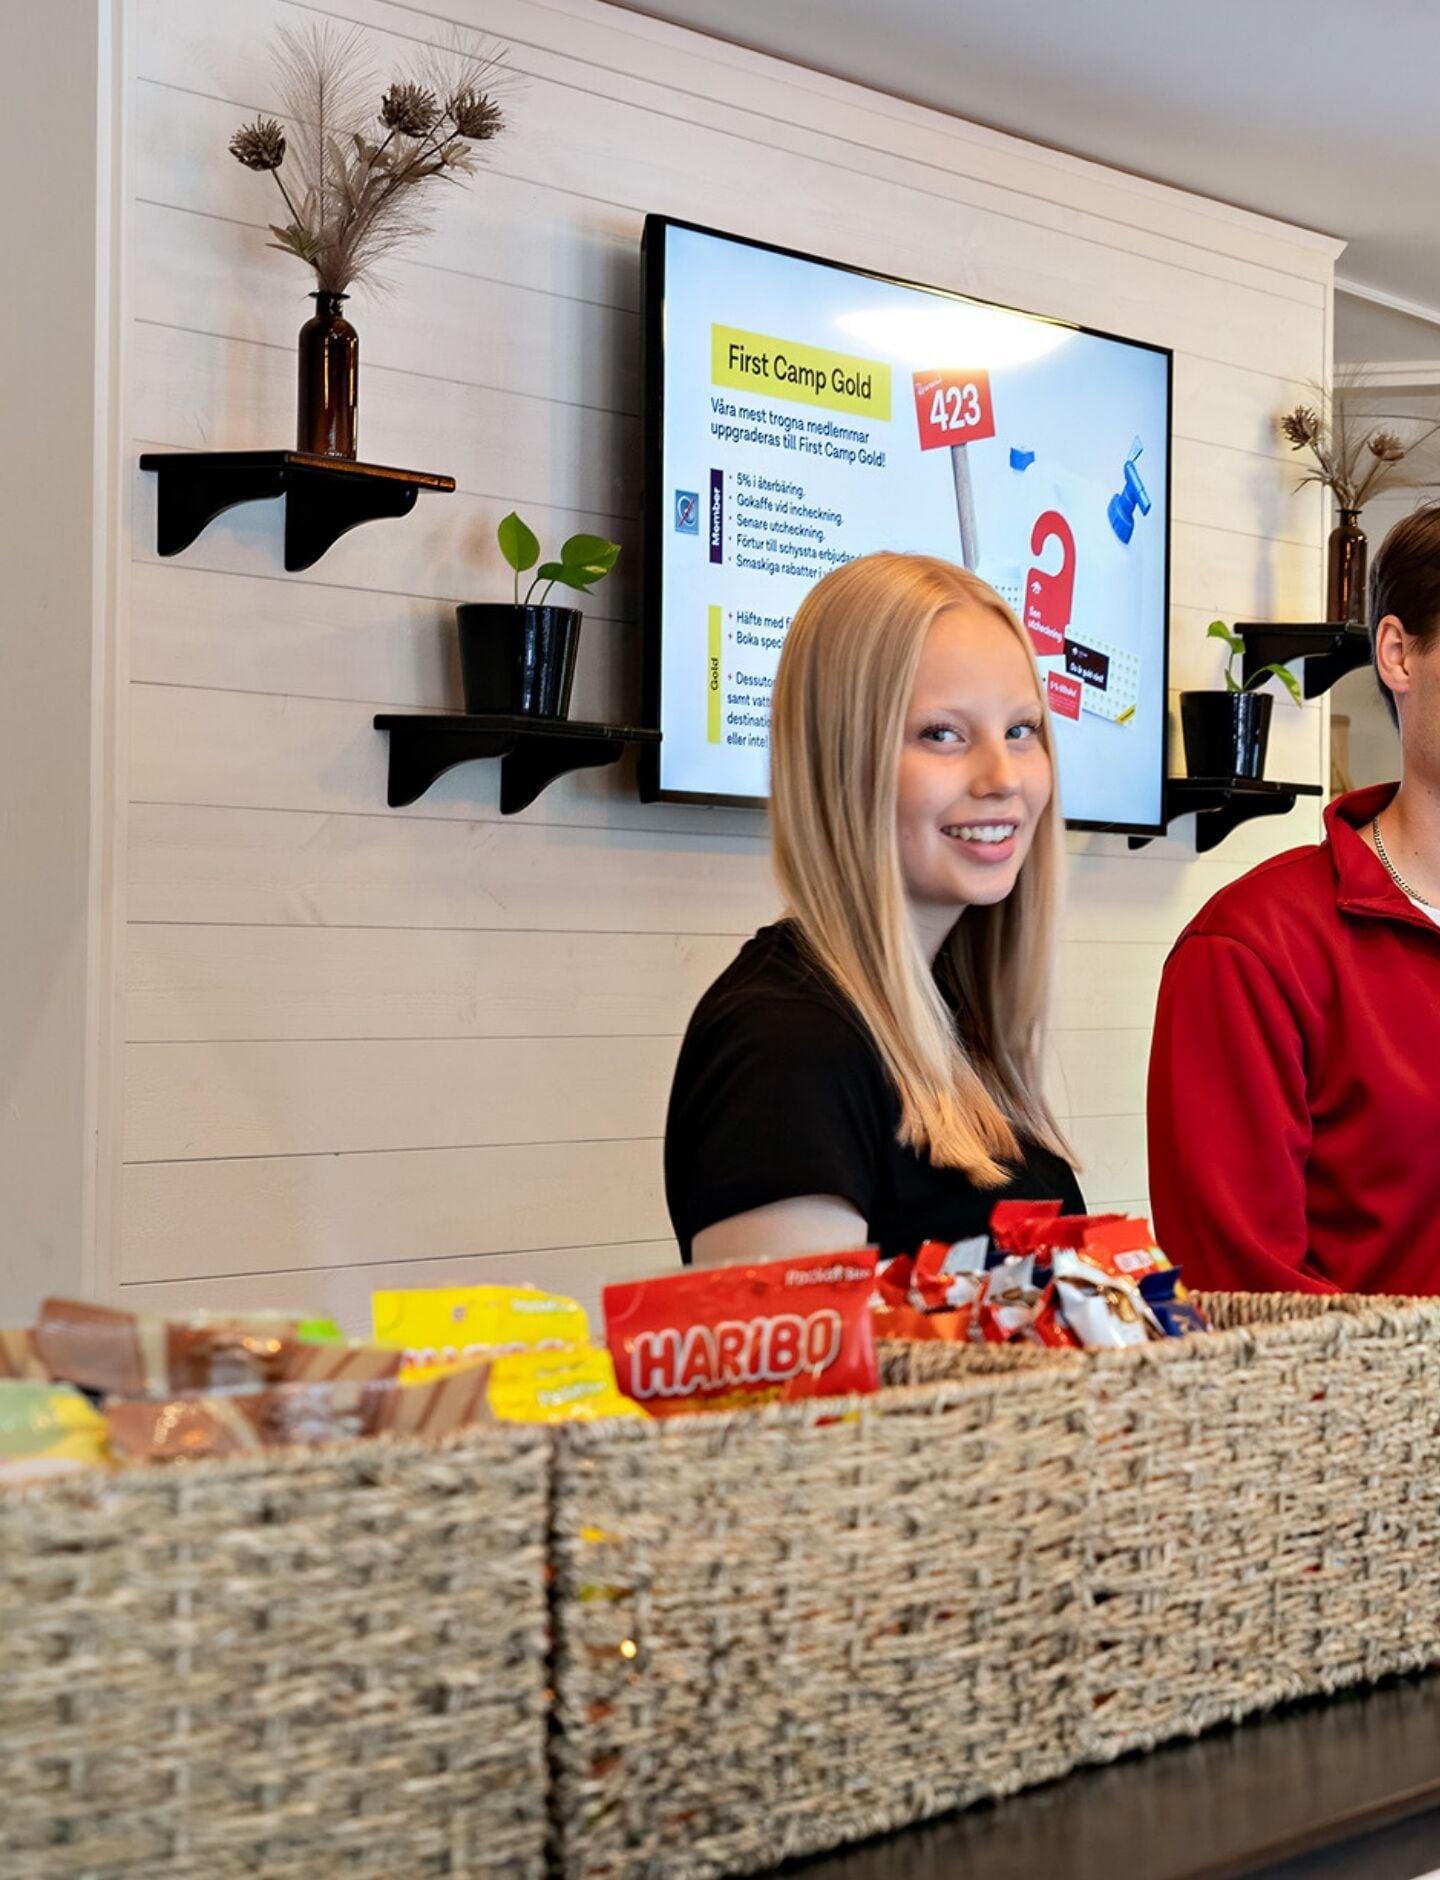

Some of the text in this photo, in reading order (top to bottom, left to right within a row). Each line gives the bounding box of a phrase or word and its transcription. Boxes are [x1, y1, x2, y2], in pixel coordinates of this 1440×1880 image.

[729, 343, 872, 400] First Camp Gold
[710, 397, 870, 444] Våra mest trogna medlemmar
[930, 383, 982, 432] 423
[710, 422, 886, 468] uppgraderas till First Camp Gold!
[736, 471, 752, 487] 5%
[711, 487, 722, 546] Member
[736, 493, 773, 511] Gokaffe
[775, 500, 789, 514] vid
[736, 513, 769, 530] Senare
[736, 533, 764, 550] Förtur
[765, 538, 778, 552] till
[779, 541, 817, 559] schyssta
[736, 553, 780, 576] Smaskiga
[781, 562, 818, 579] rabatter
[736, 610, 763, 626] Häfte
[764, 615, 784, 629] med
[736, 630, 759, 646] Boka
[710, 657, 720, 691] Gold
[727, 693, 751, 706] samt
[726, 731, 747, 746] eller
[631, 1308, 842, 1399] HARIBO
